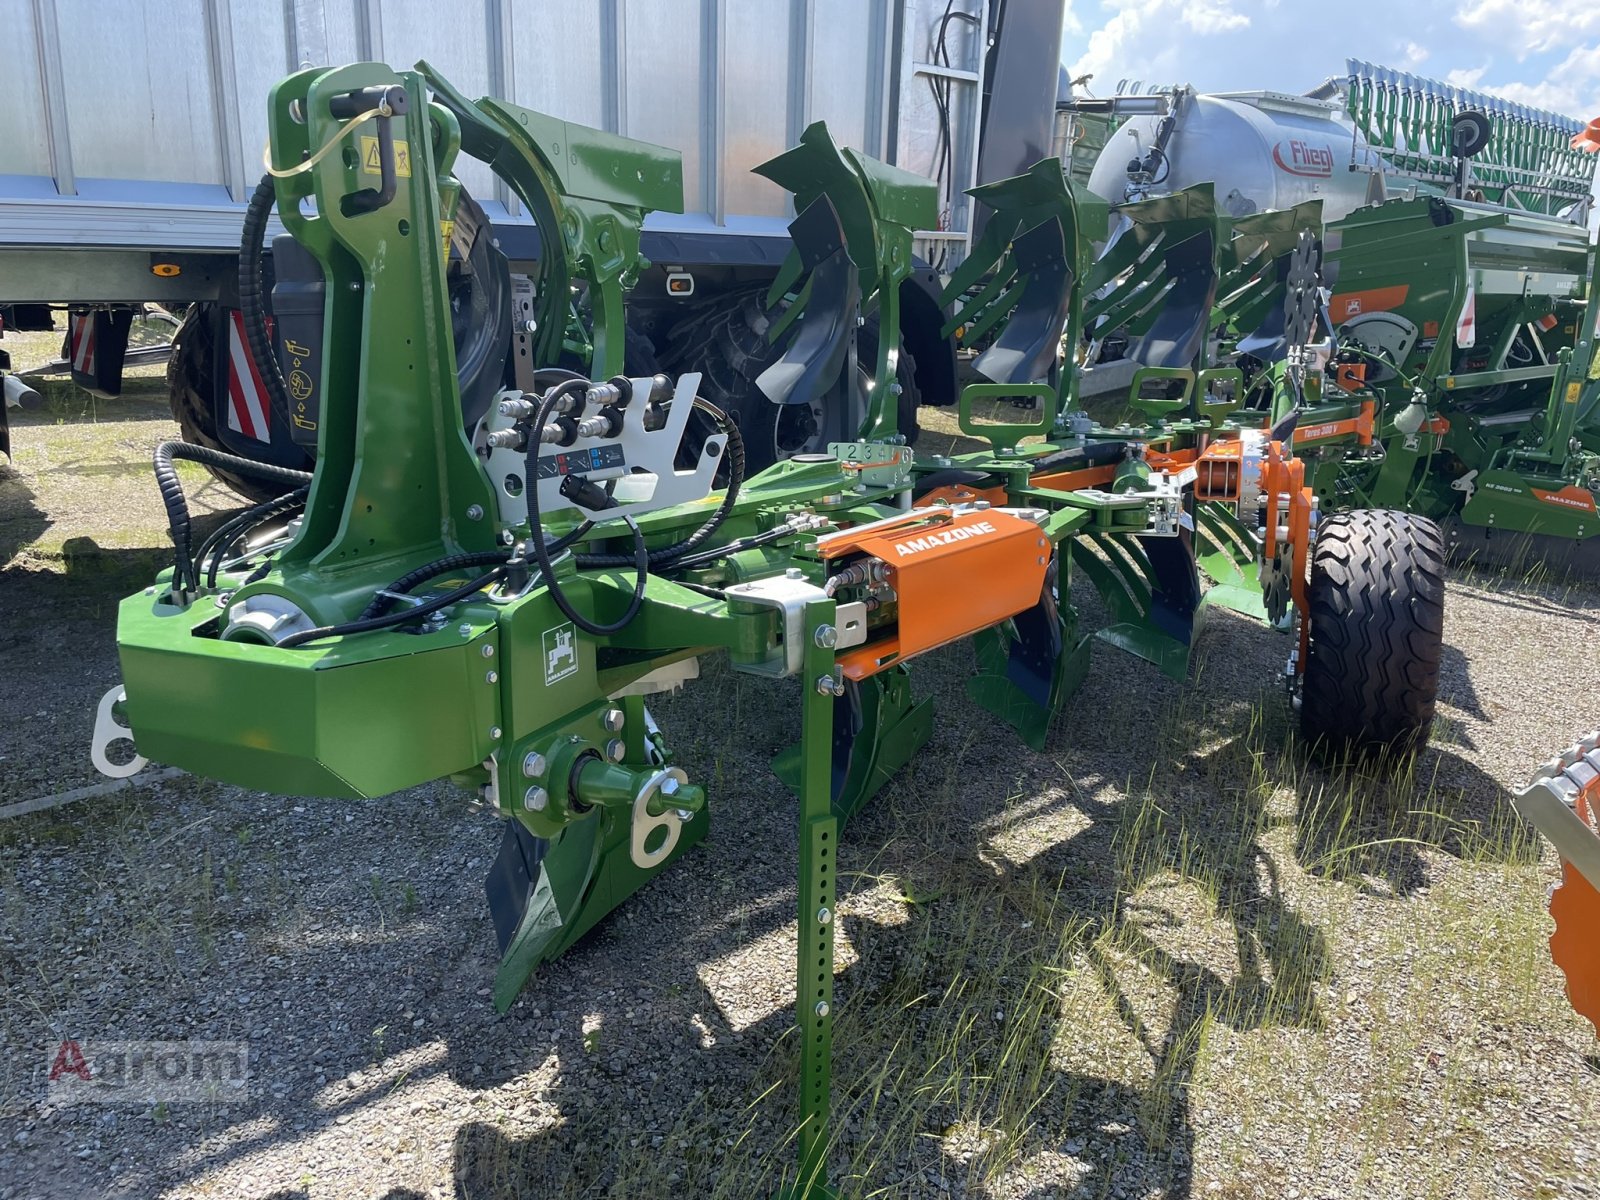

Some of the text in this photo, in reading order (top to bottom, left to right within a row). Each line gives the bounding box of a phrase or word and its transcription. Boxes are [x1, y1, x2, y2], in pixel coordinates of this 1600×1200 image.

[1289, 140, 1334, 172] Fliegl
[833, 445, 839, 457] 1
[848, 445, 857, 458] 2
[864, 446, 872, 460] 3
[901, 449, 909, 464] 6
[1544, 495, 1590, 508] AMAZONE
[894, 521, 997, 557] AMAZONE
[547, 664, 577, 682] AMAZONE
